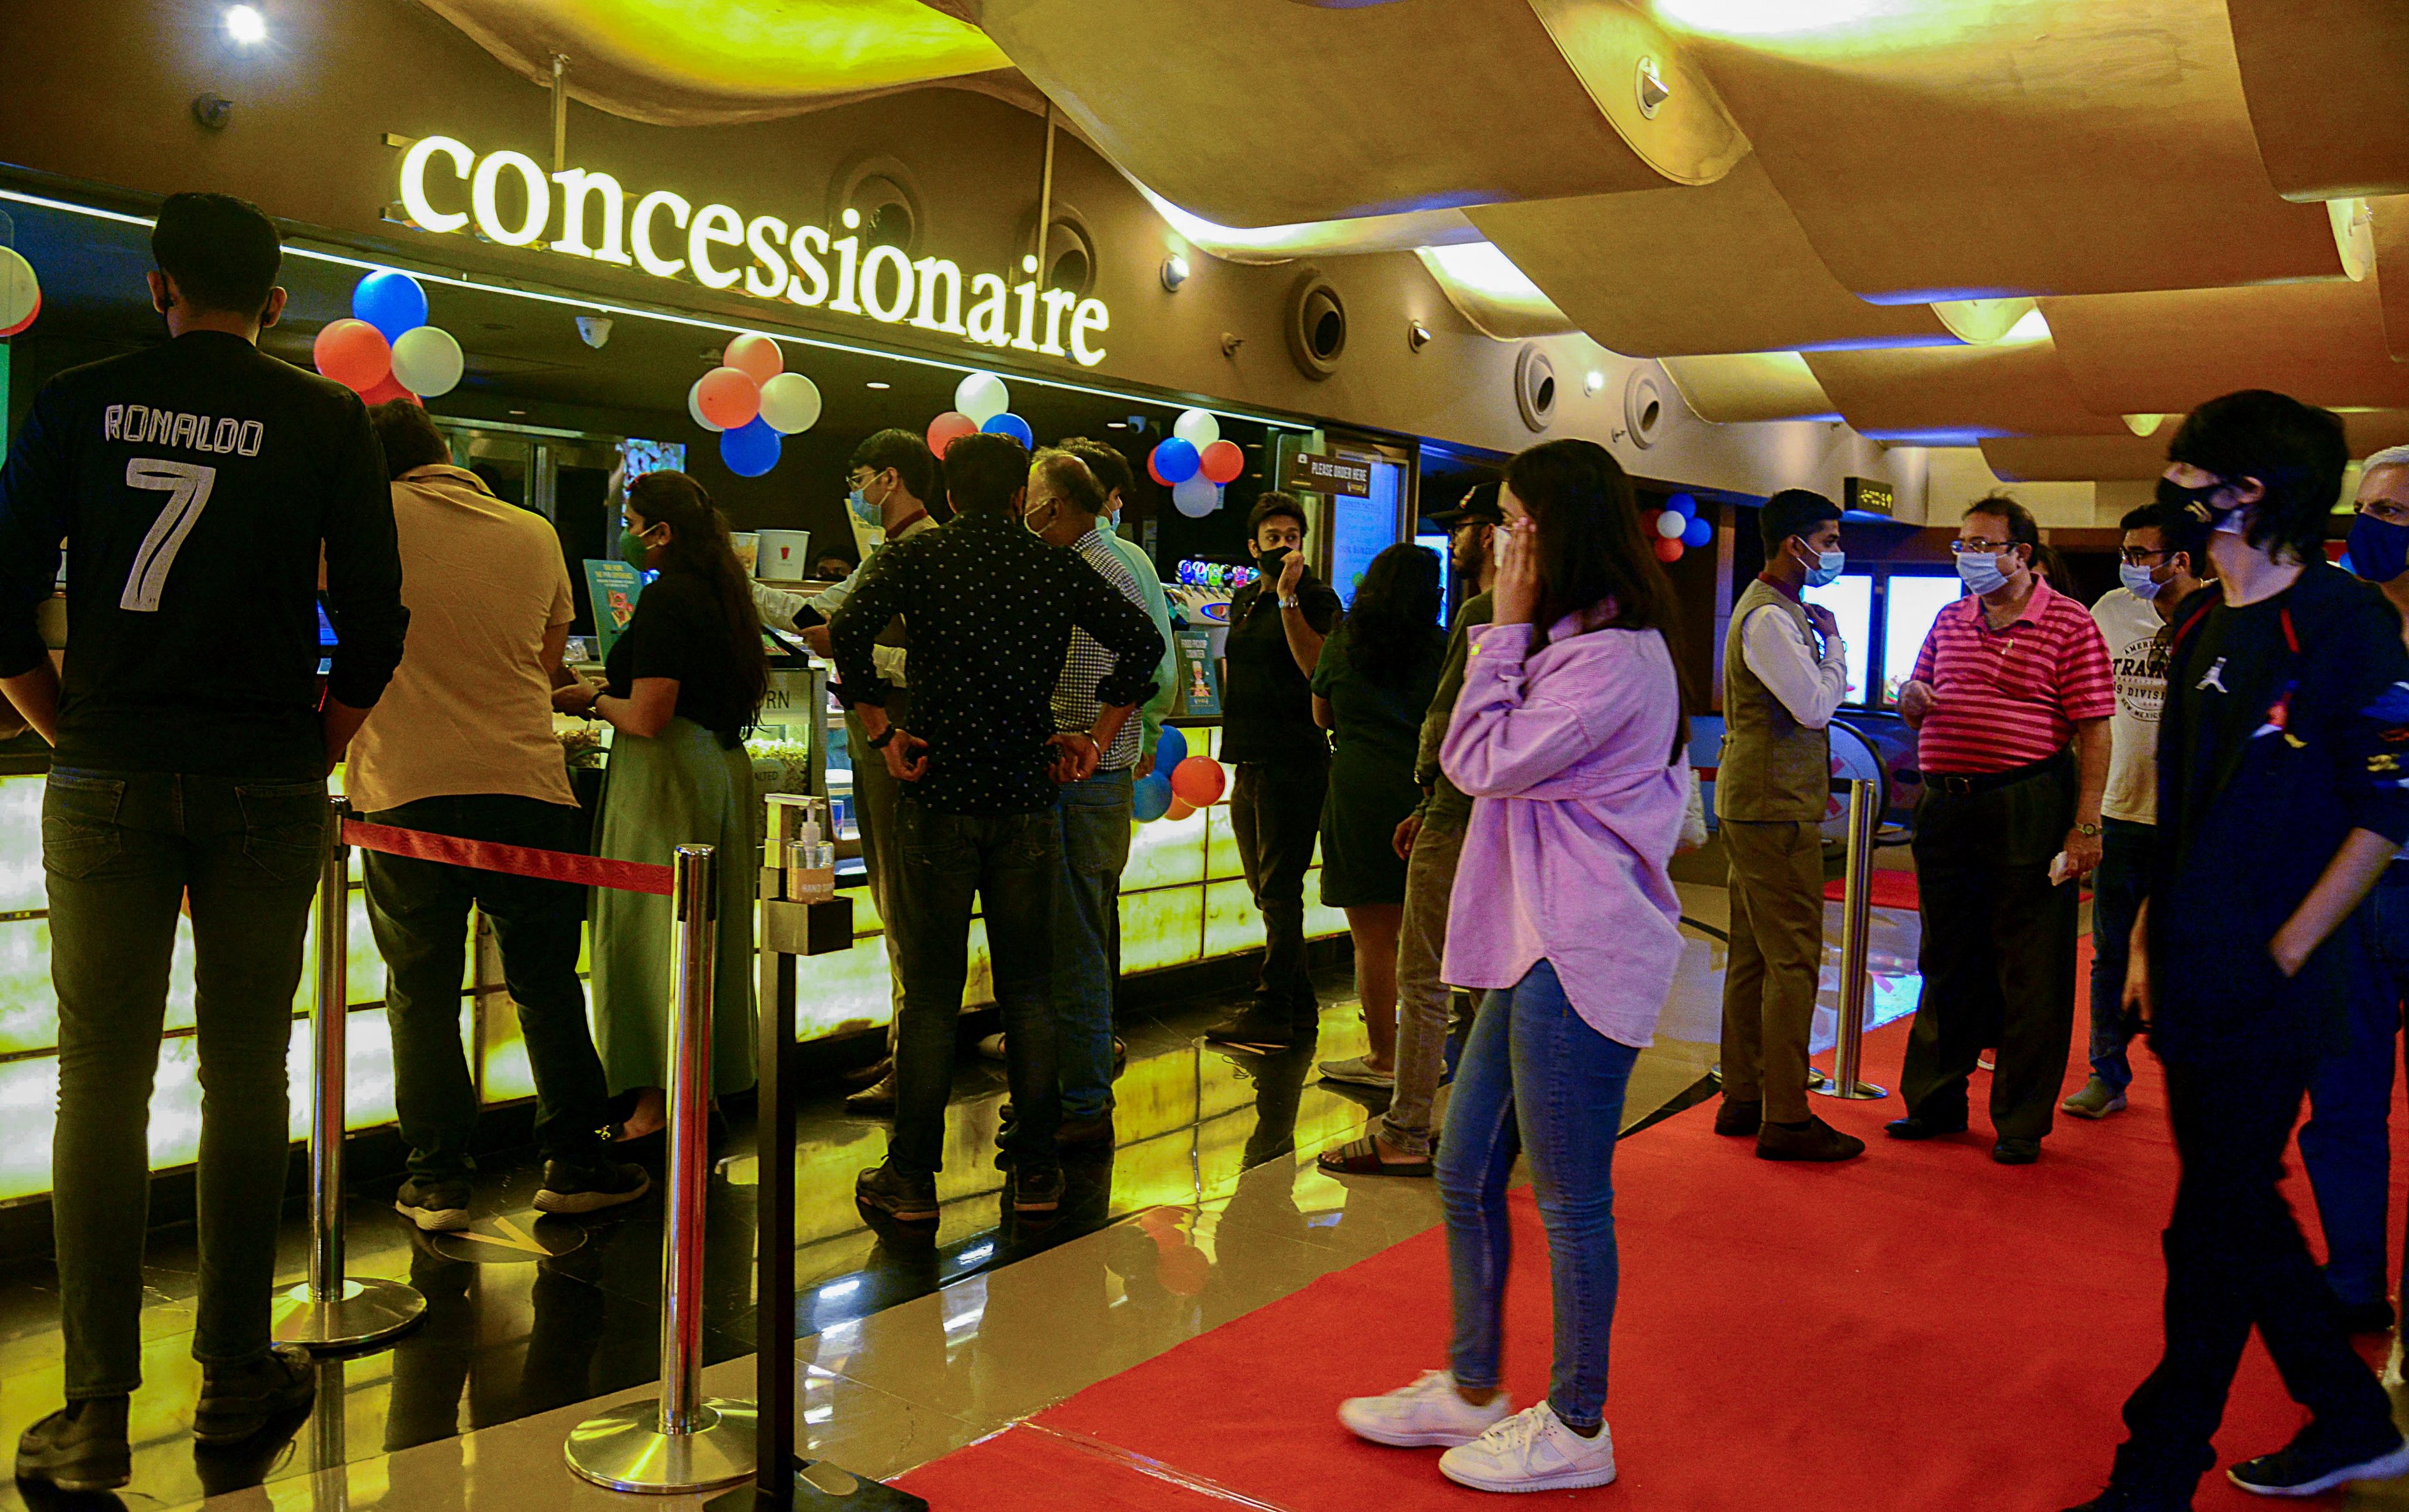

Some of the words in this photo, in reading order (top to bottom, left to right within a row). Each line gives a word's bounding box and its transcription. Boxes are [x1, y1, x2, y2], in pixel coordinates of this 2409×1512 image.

[399, 136, 1110, 367] concessionaire
[105, 405, 263, 456] RONALDO
[1311, 462, 1333, 477] PLEASE
[1334, 465, 1352, 479] ORDER
[1353, 468, 1367, 481] HERE
[120, 458, 216, 612] 7
[2127, 687, 2166, 701] DIVISI
[754, 771, 780, 780] ALTED
